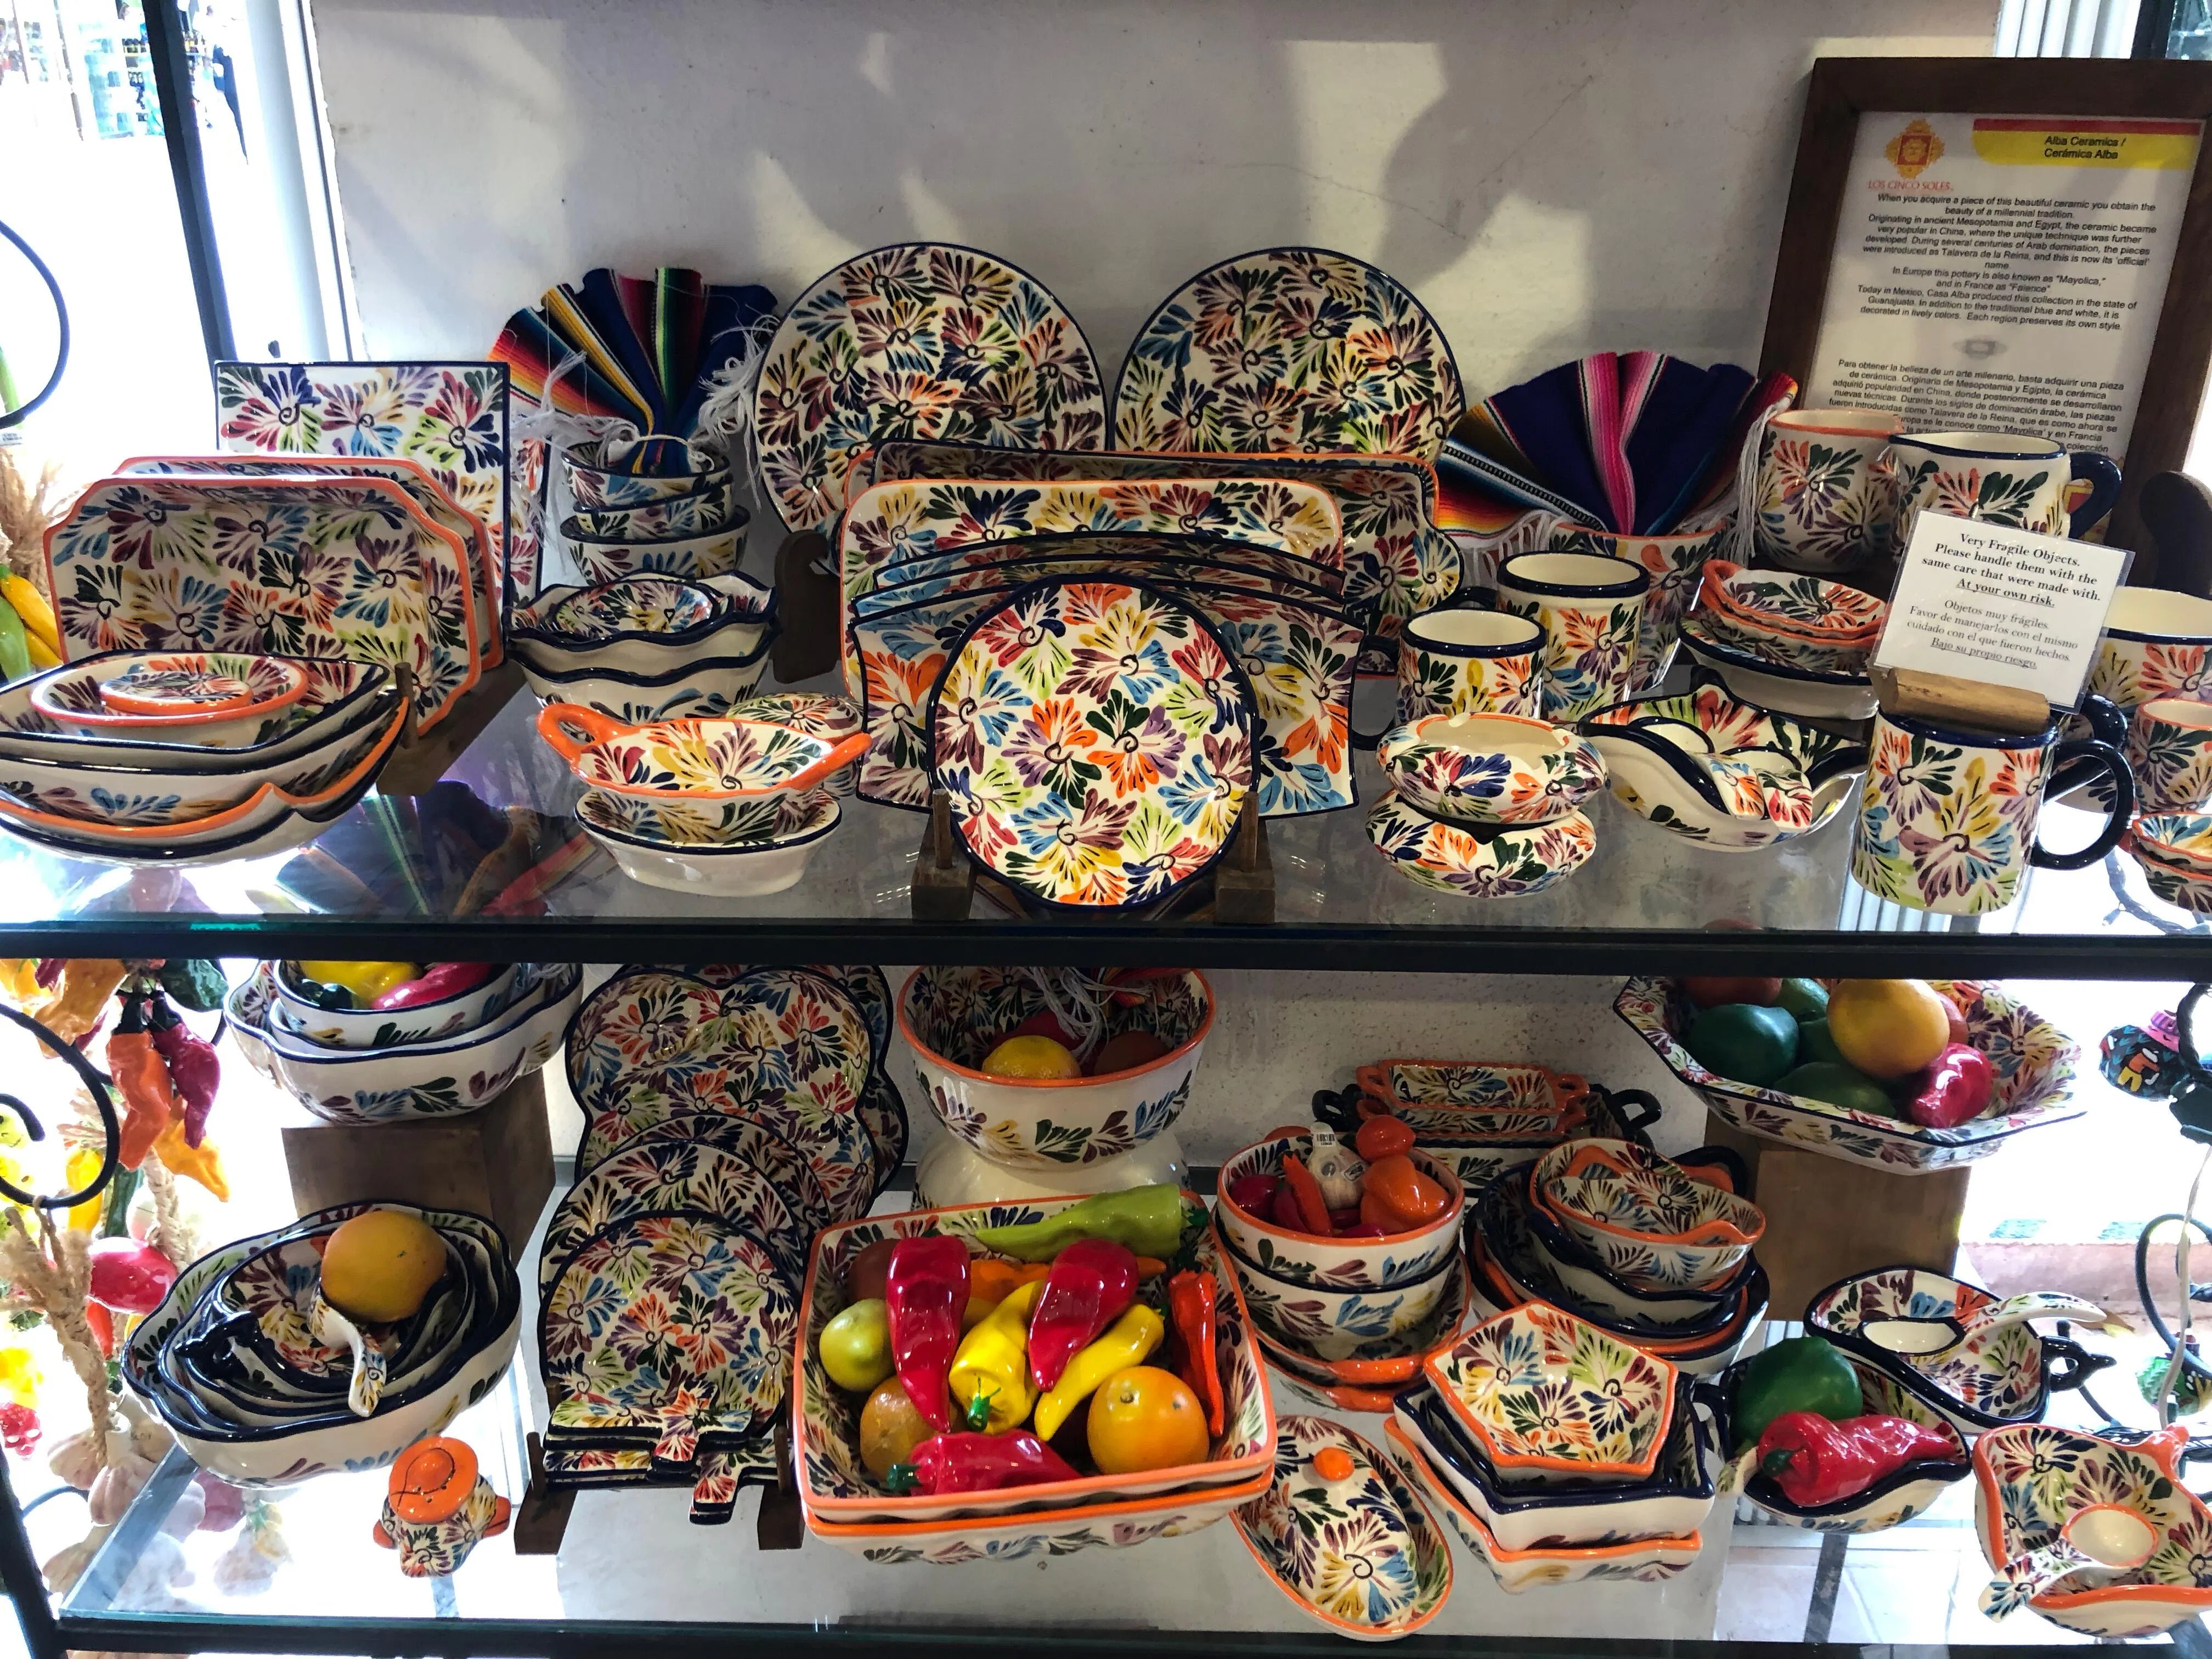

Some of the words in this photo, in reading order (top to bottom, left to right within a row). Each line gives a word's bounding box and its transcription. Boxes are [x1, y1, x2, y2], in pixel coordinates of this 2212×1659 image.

[2044, 136, 2068, 145] Alba
[2070, 136, 2119, 146] Ceramics
[2044, 148, 2092, 158] Cerámica
[2094, 149, 2118, 159] Alba
[1868, 180, 1886, 189] LOS
[1886, 180, 1920, 190] CINCO
[1878, 193, 1901, 202] When
[1902, 195, 1918, 204] you
[1920, 196, 1951, 205] acquire
[1960, 197, 1984, 206] piece
[1986, 197, 1995, 205] of
[1996, 198, 2012, 206] this
[2014, 198, 2052, 207] beautiful
[2054, 200, 2090, 208] ceramic
[2111, 202, 2138, 210] obtain
[2141, 202, 2156, 211] the
[1945, 206, 1974, 216] beauty
[1976, 207, 1985, 215] of
[1994, 208, 2035, 217] millennial
[1878, 227, 1895, 236] very
[1896, 226, 1928, 238] popular
[1969, 229, 1995, 237] where
[1997, 229, 2011, 238] the
[2013, 230, 2043, 240] unique
[2045, 232, 2089, 242] technique
[2112, 234, 2142, 243] further
[1956, 217, 2013, 227] Mesopotamia
[2016, 220, 2033, 228] and
[2065, 222, 2080, 230] the
[2120, 224, 2157, 233] became
[1911, 236, 1939, 247] During
[1941, 239, 1972, 247] several
[1974, 240, 2013, 249] centuries
[2025, 241, 2047, 250] Arab
[2104, 245, 2119, 253] the
[2120, 247, 2151, 256] pieces
[1942, 247, 1978, 257] Talavera
[2034, 252, 2051, 261] and
[2053, 253, 2069, 262] this
[1902, 267, 1933, 277] Europe
[1934, 269, 1949, 277] this
[1950, 270, 1980, 280] pottery
[2011, 273, 2041, 281] known
[1936, 278, 1953, 288] and
[1964, 279, 1994, 290] France
[1858, 285, 1882, 295] Today
[1927, 289, 1949, 298] Casa
[1950, 290, 1970, 299] Alba
[1972, 293, 2013, 301] produced
[2014, 294, 2029, 302] this
[2032, 296, 2074, 305] collection
[2086, 298, 2101, 307] the
[1860, 306, 1900, 315] decorated
[1911, 309, 1933, 319] lively
[1967, 312, 1989, 321] Each
[1990, 315, 2018, 324] region
[2019, 317, 2063, 326] preserves
[1929, 300, 1962, 309] addition
[1974, 302, 1988, 311] the
[1990, 304, 2033, 313] traditional
[2034, 306, 2053, 315] blue
[1961, 533, 1985, 549] Very
[1989, 539, 2029, 556] Fragile
[2033, 549, 2080, 566] Objects.
[1935, 543, 1971, 558] Please
[1974, 551, 2012, 567] handle
[2016, 561, 2045, 574] them
[2050, 568, 2074, 580] with
[2078, 573, 2097, 584] the
[1922, 558, 1950, 569] same
[1954, 565, 1977, 574] care
[1980, 568, 2003, 580] that
[2008, 575, 2034, 586] were
[2038, 582, 2069, 594] made
[2073, 588, 2100, 600] with.
[1956, 578, 1971, 590] At
[1973, 584, 2001, 596] your
[2004, 590, 2027, 602] own
[2029, 594, 2055, 607] risk.
[1944, 600, 1982, 614] Objetos
[1985, 611, 2007, 623] muy
[1910, 606, 1938, 619] Favor
[1940, 612, 1952, 622] de
[1955, 618, 2009, 634] manejarlos
[2011, 630, 2030, 639] con
[2032, 633, 2042, 641] el
[2044, 637, 2078, 648] mismo
[1907, 621, 1945, 634] cuidado
[1947, 630, 1965, 639] con
[1967, 632, 1977, 641] el
[1979, 637, 1997, 646] que
[2000, 639, 2032, 653] fueron
[1930, 637, 1953, 652] Bajo
[1954, 645, 1967, 655] su
[1967, 648, 2002, 662] propio
